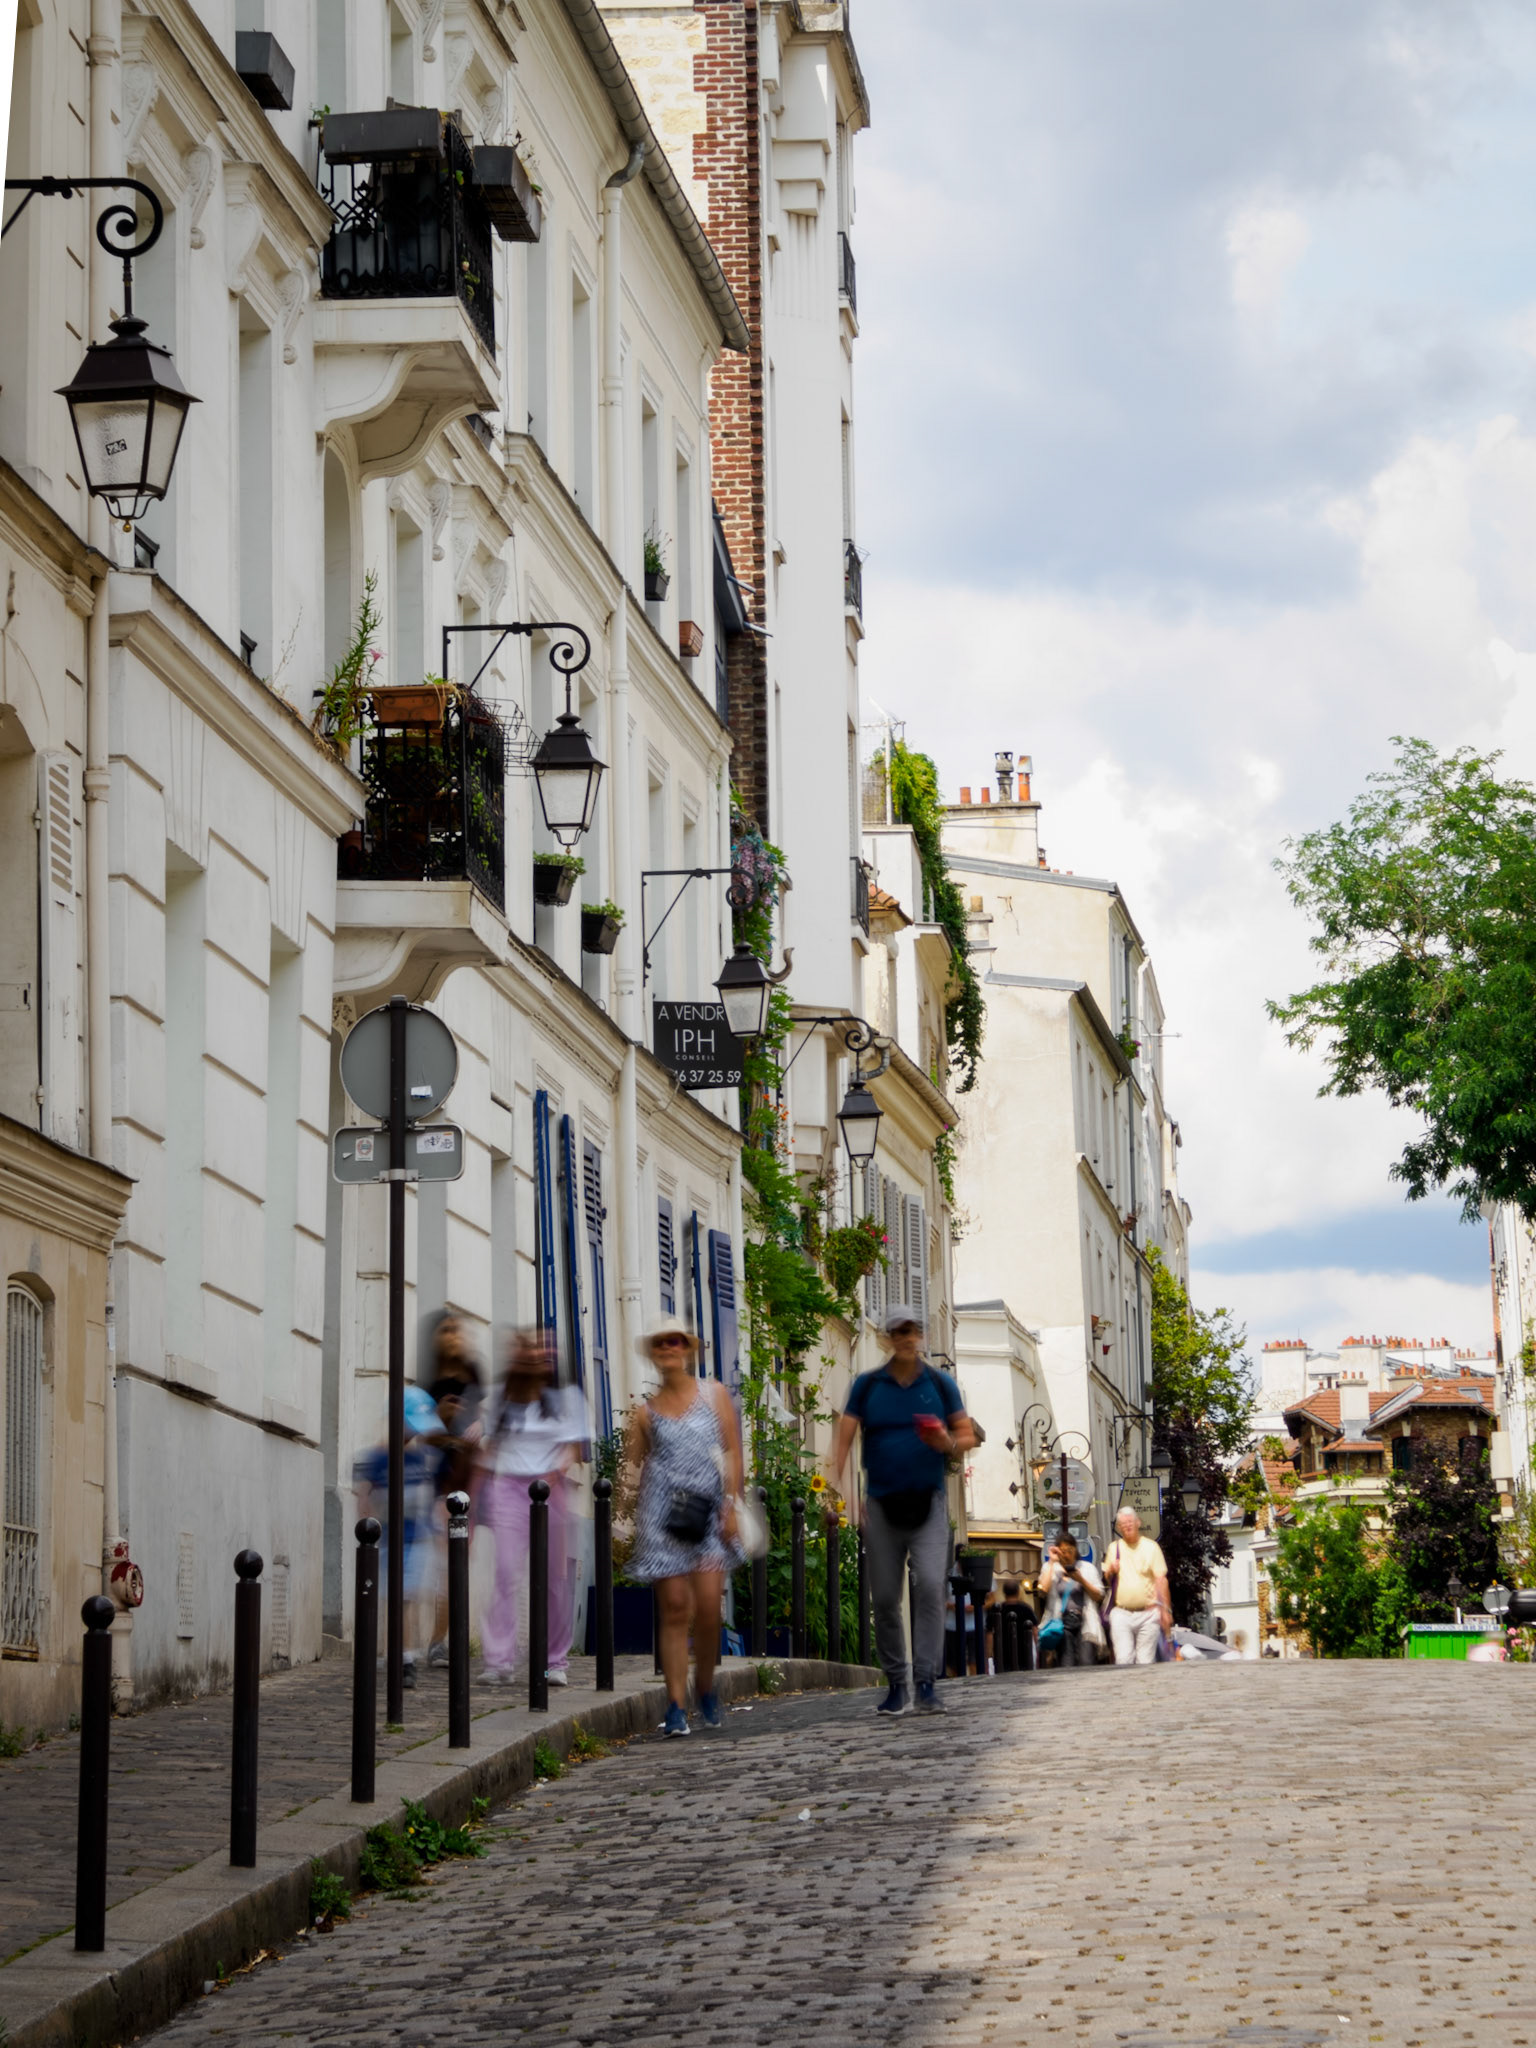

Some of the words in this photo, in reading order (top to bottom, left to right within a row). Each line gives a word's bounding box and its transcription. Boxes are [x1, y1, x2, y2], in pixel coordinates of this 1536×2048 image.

[658, 1005, 669, 1020] A
[674, 1005, 725, 1021] VENDR
[675, 1029, 715, 1053] IPH
[689, 1069, 704, 1083] 37
[707, 1070, 723, 1083] 25
[726, 1070, 742, 1083] 59
[1133, 1505, 1158, 1513] tmartre
